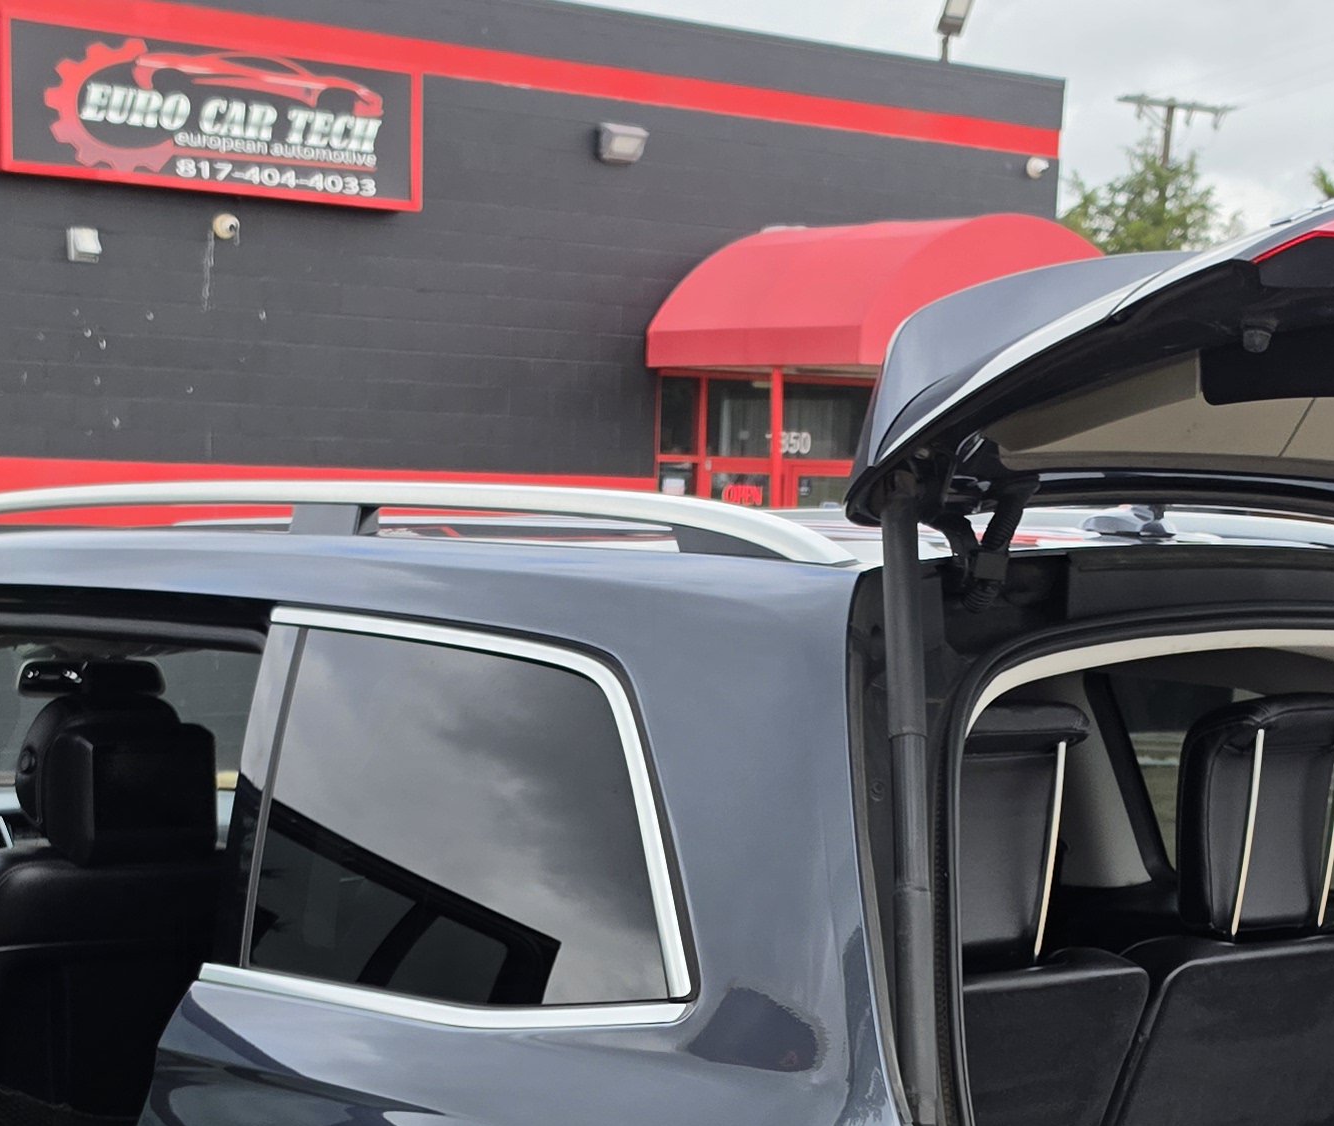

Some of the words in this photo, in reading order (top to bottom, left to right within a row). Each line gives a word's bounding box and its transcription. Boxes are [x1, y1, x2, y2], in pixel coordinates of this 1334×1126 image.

[79, 82, 191, 131] EURO
[198, 96, 278, 141] CAR
[285, 107, 383, 154] TECH
[173, 131, 268, 155] european
[269, 141, 378, 168] automotive
[175, 157, 377, 197] 817-404-4033
[722, 483, 764, 506] OPEN
